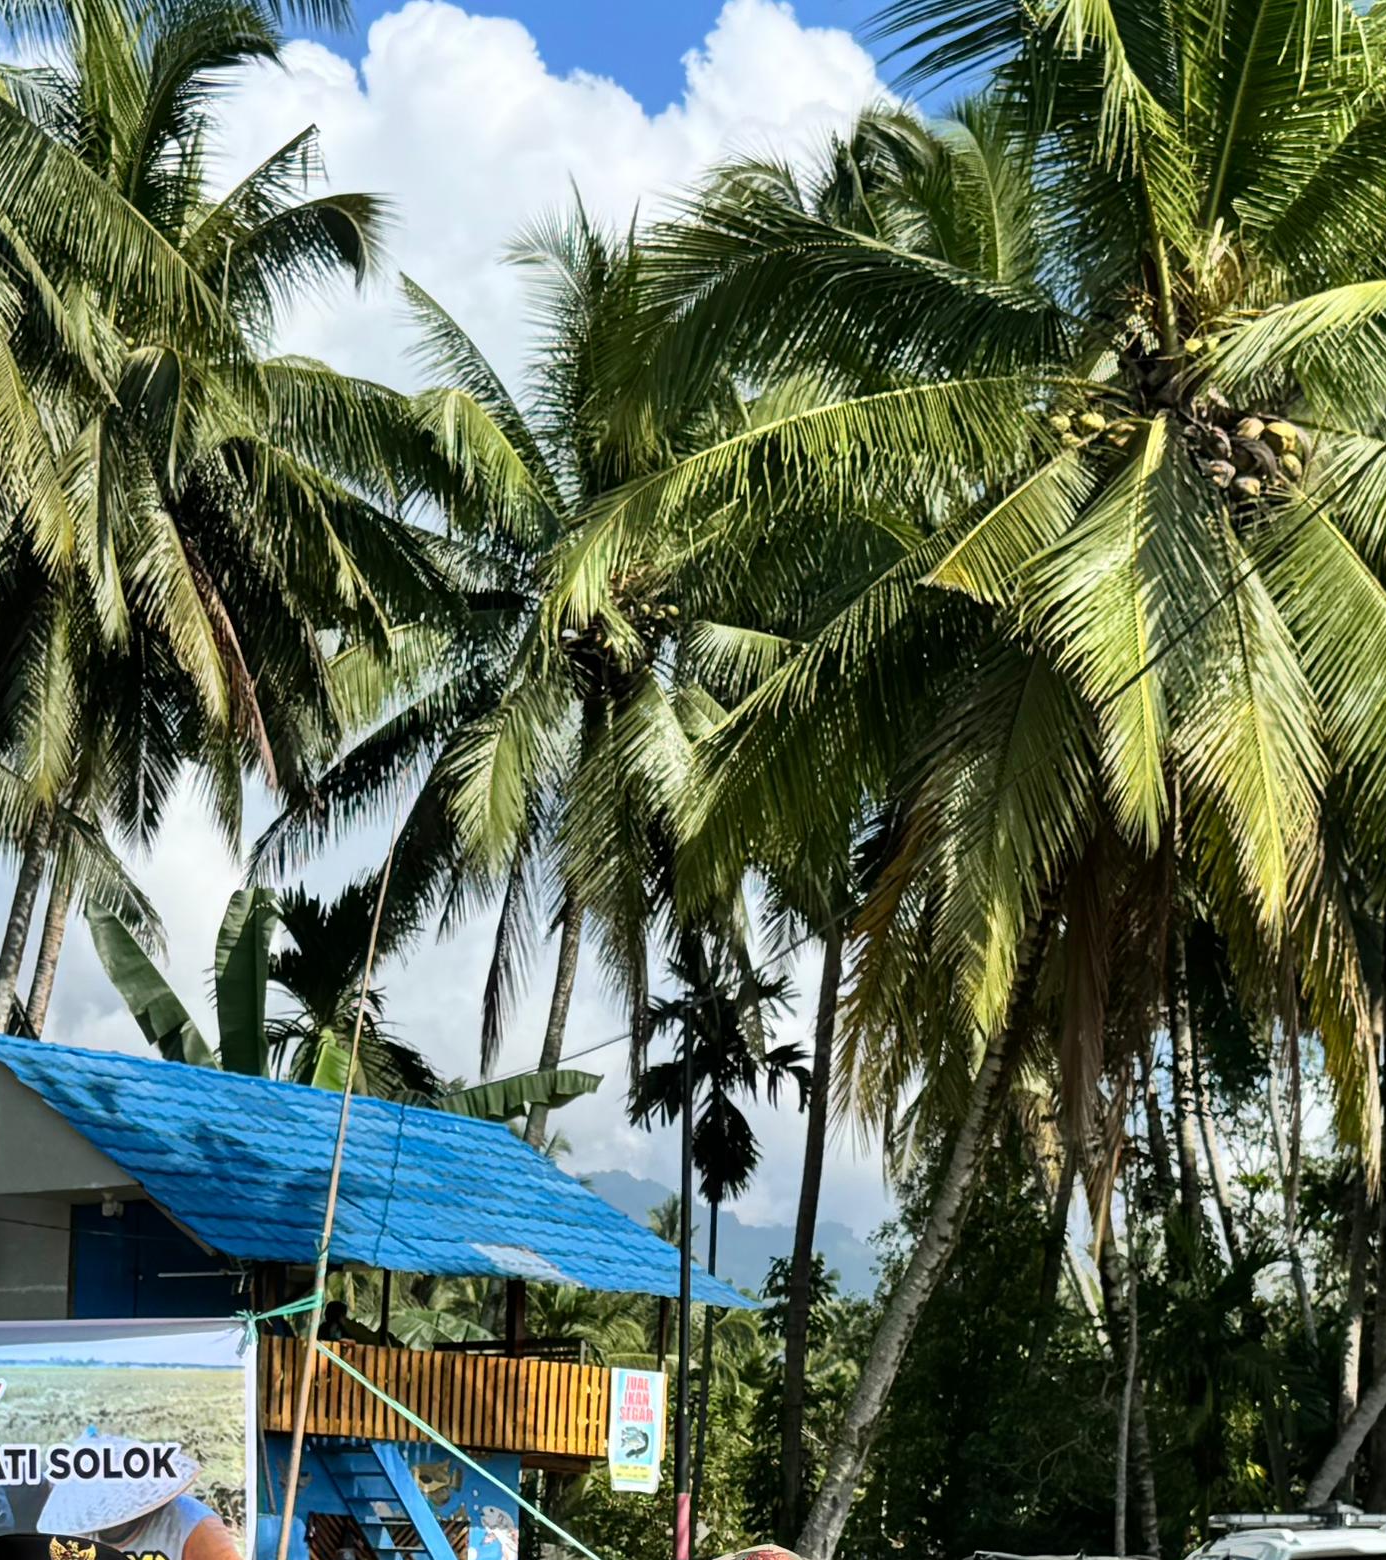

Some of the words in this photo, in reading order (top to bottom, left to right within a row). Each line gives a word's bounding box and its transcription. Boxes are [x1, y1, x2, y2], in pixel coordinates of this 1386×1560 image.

[624, 1391, 650, 1407] IKAN
[619, 1406, 654, 1424] SEGAR
[49, 1447, 178, 1480] SOLOK
